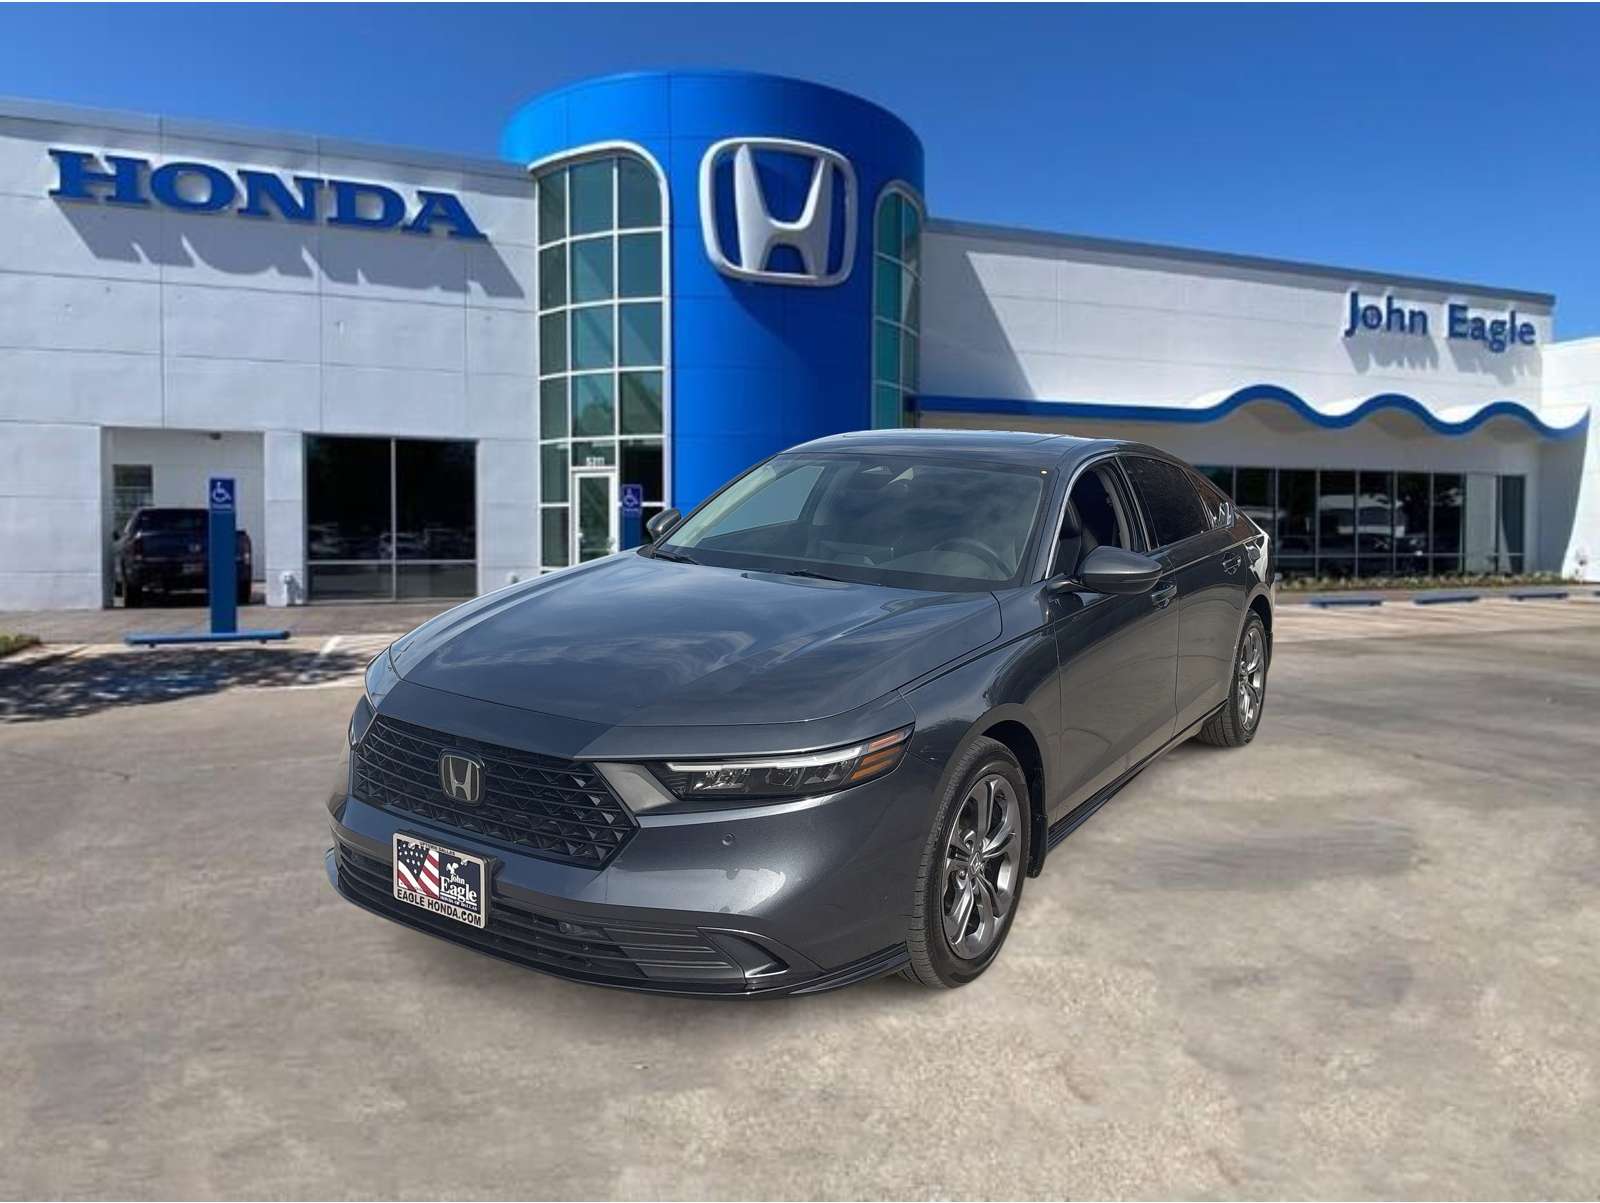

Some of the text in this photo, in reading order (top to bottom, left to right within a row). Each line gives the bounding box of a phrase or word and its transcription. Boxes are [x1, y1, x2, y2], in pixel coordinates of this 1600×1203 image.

[48, 148, 488, 240] HONDA
[1344, 290, 1536, 353] John Eagle
[440, 875, 478, 903] Eagle
[450, 874, 466, 885] John
[397, 888, 481, 927] EAGLE HONDA.COM
